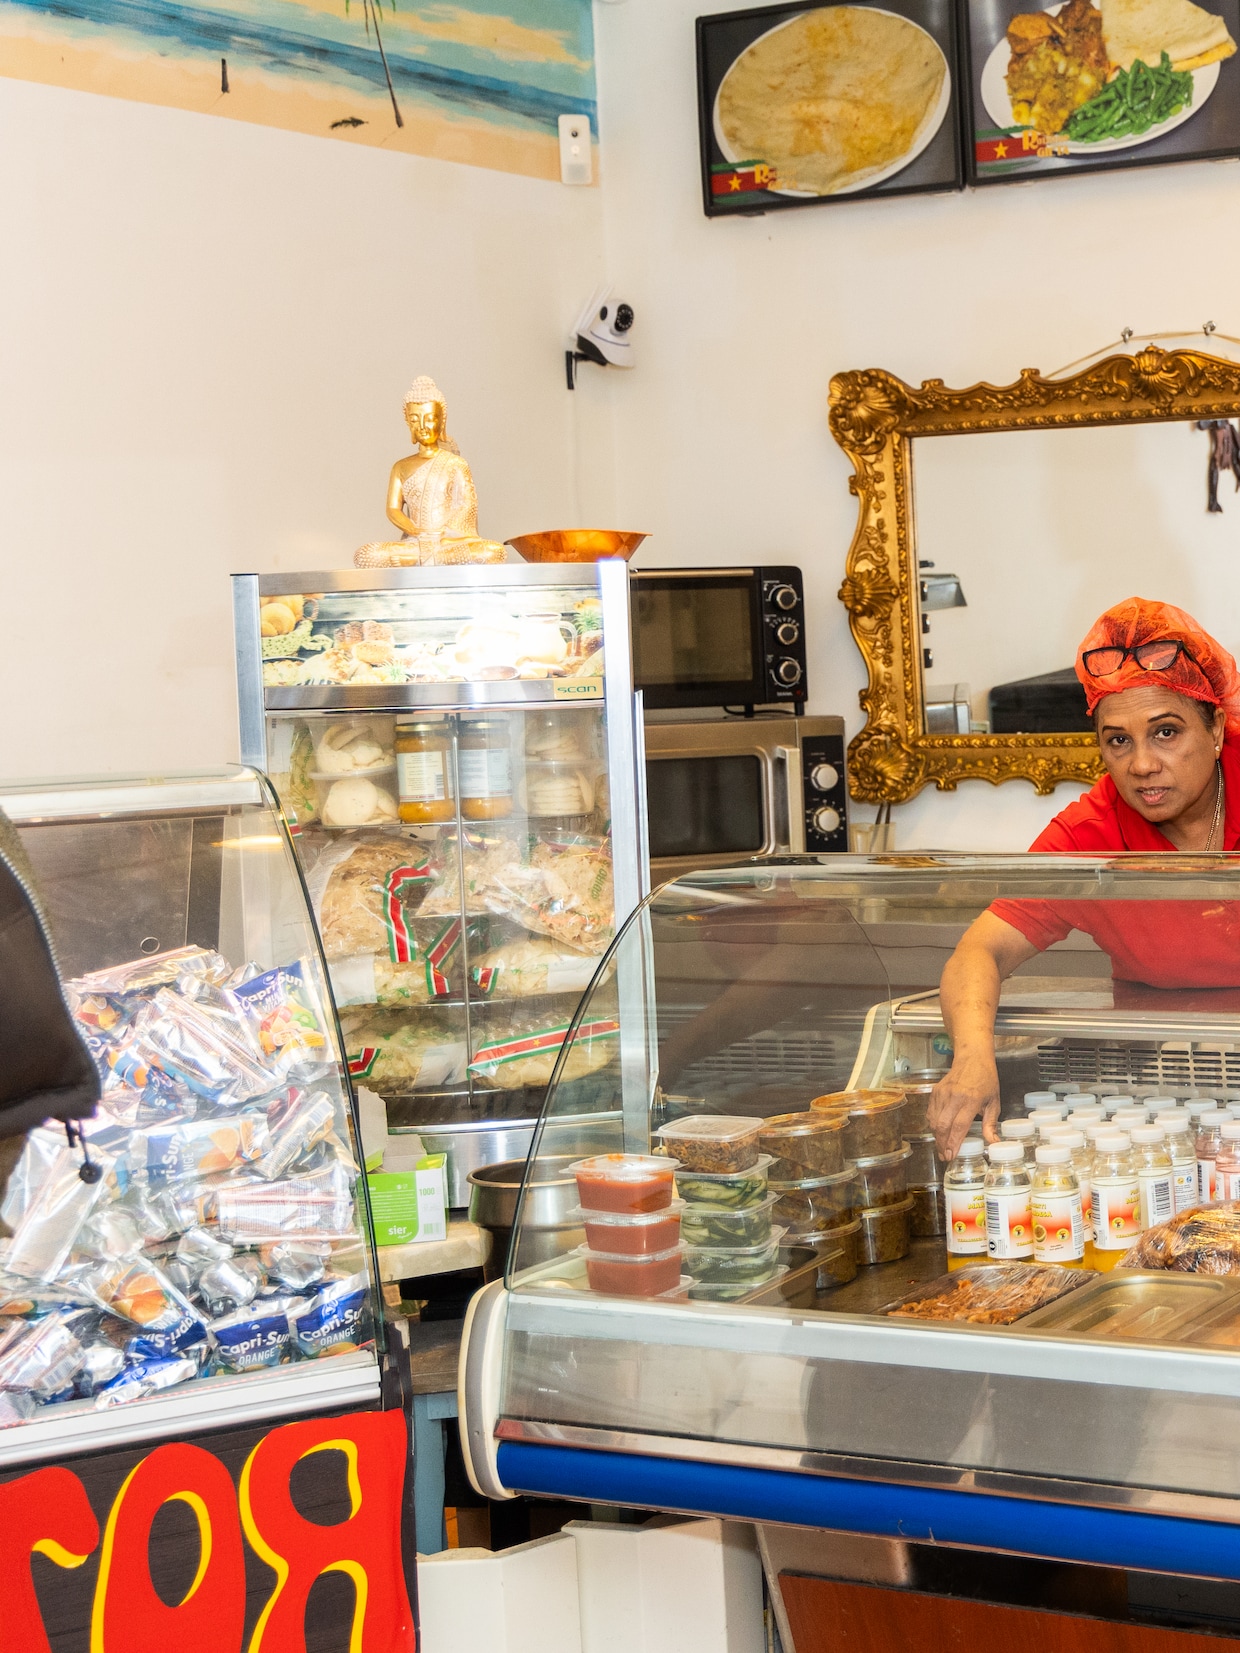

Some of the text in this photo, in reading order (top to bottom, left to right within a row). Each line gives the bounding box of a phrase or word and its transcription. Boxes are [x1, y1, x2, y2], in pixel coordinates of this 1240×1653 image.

[557, 685, 596, 693] scan
[419, 1187, 435, 1197] 1000
[388, 1224, 408, 1235] sier
[320, 1326, 357, 1346] ORANGE
[219, 1331, 290, 1356] Capri-Sun
[238, 1349, 277, 1366] ORANGE
